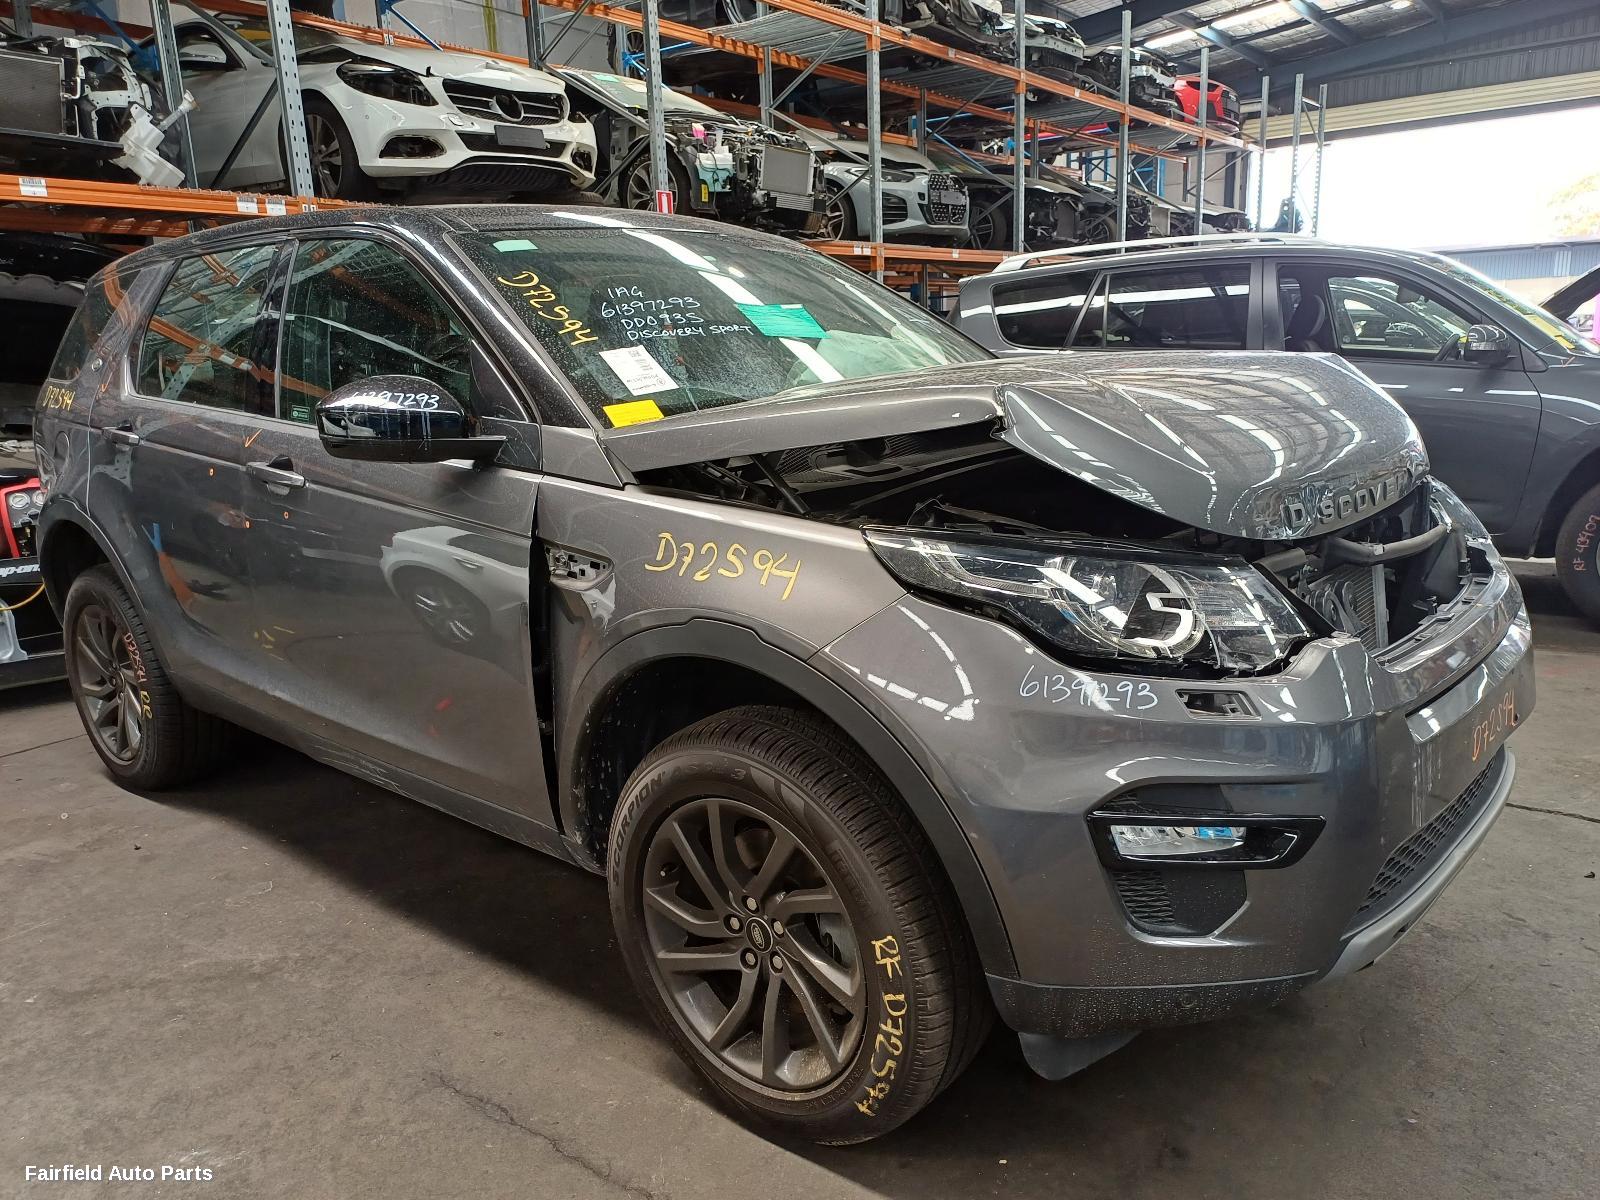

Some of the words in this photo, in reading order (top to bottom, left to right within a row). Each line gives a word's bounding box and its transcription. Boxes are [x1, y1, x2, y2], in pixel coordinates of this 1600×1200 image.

[601, 296, 701, 318] 61397293
[627, 325, 706, 341] DISCOVERY
[709, 323, 754, 336] SPORT
[612, 770, 666, 887] SCORPION
[871, 935, 903, 982] RF
